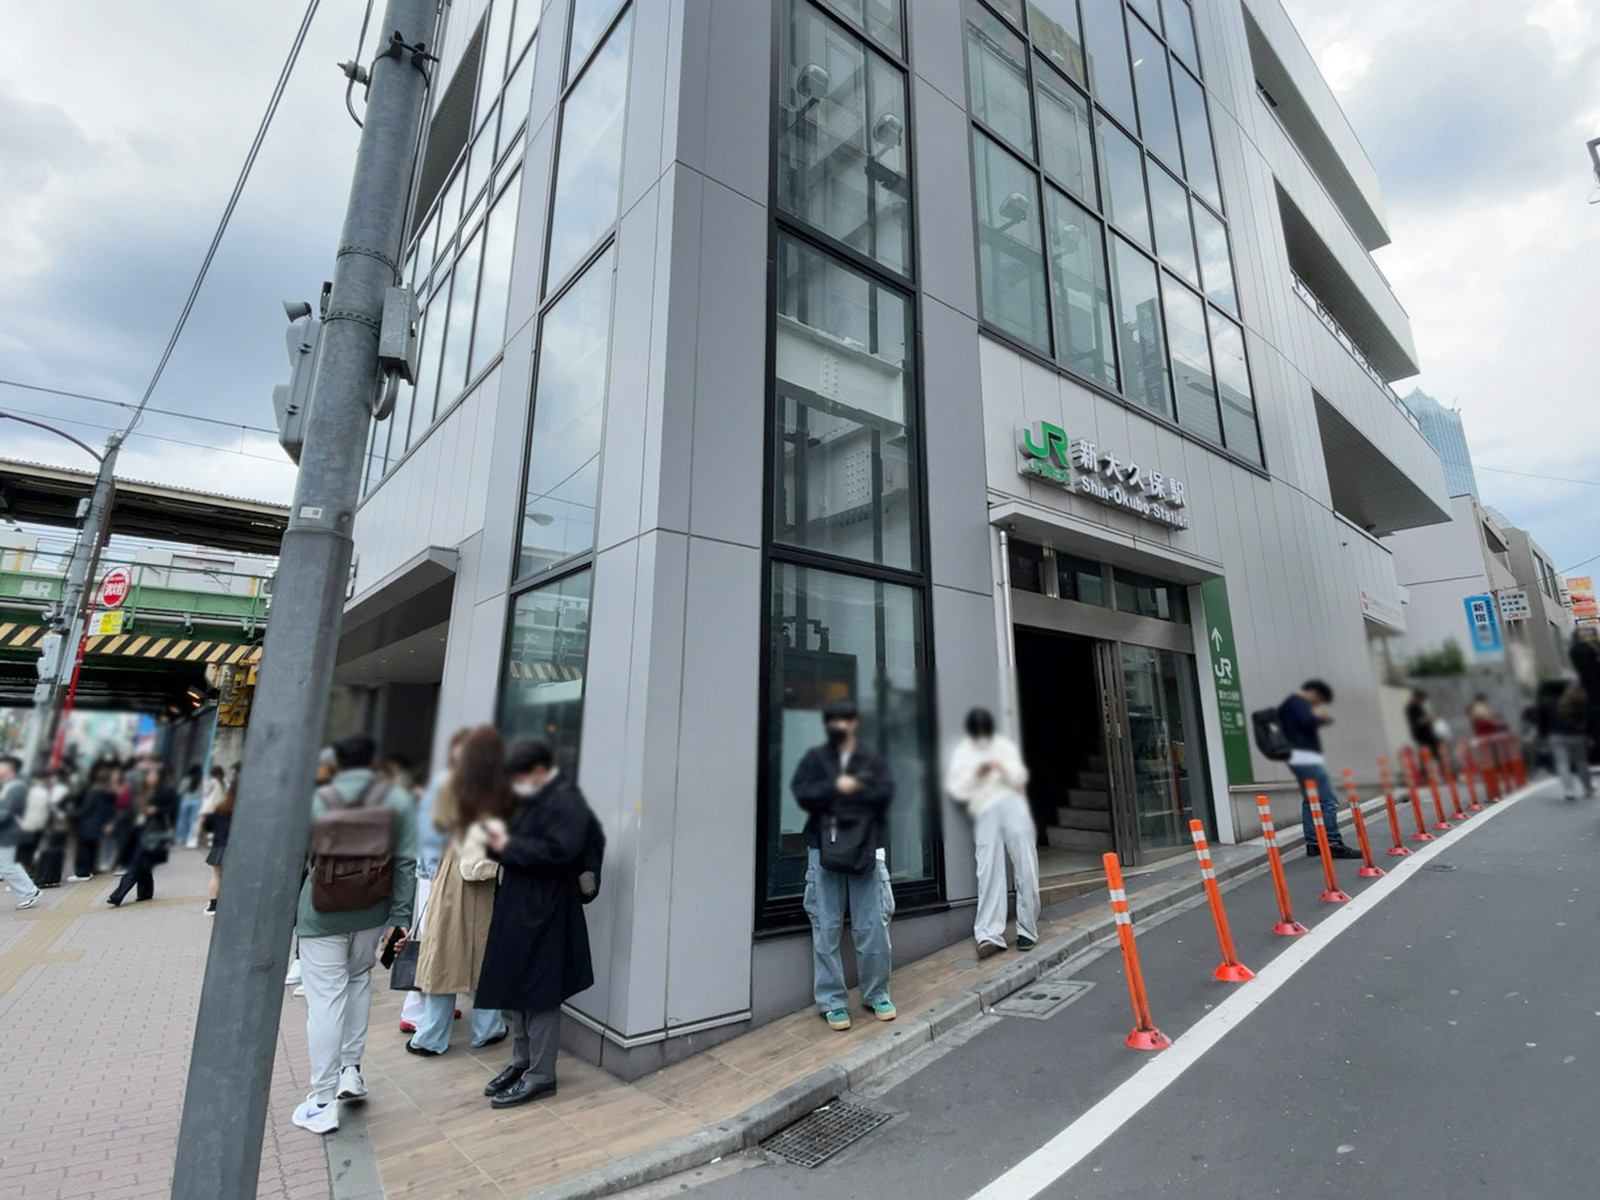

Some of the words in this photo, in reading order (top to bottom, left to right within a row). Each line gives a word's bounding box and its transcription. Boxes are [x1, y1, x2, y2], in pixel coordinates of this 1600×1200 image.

[1023, 420, 1069, 468] JR
[1079, 439, 1186, 507] 新大久保駅
[1081, 475, 1150, 515] Shin-Okubo
[1152, 502, 1190, 529] Station
[1215, 657, 1232, 679] JR
